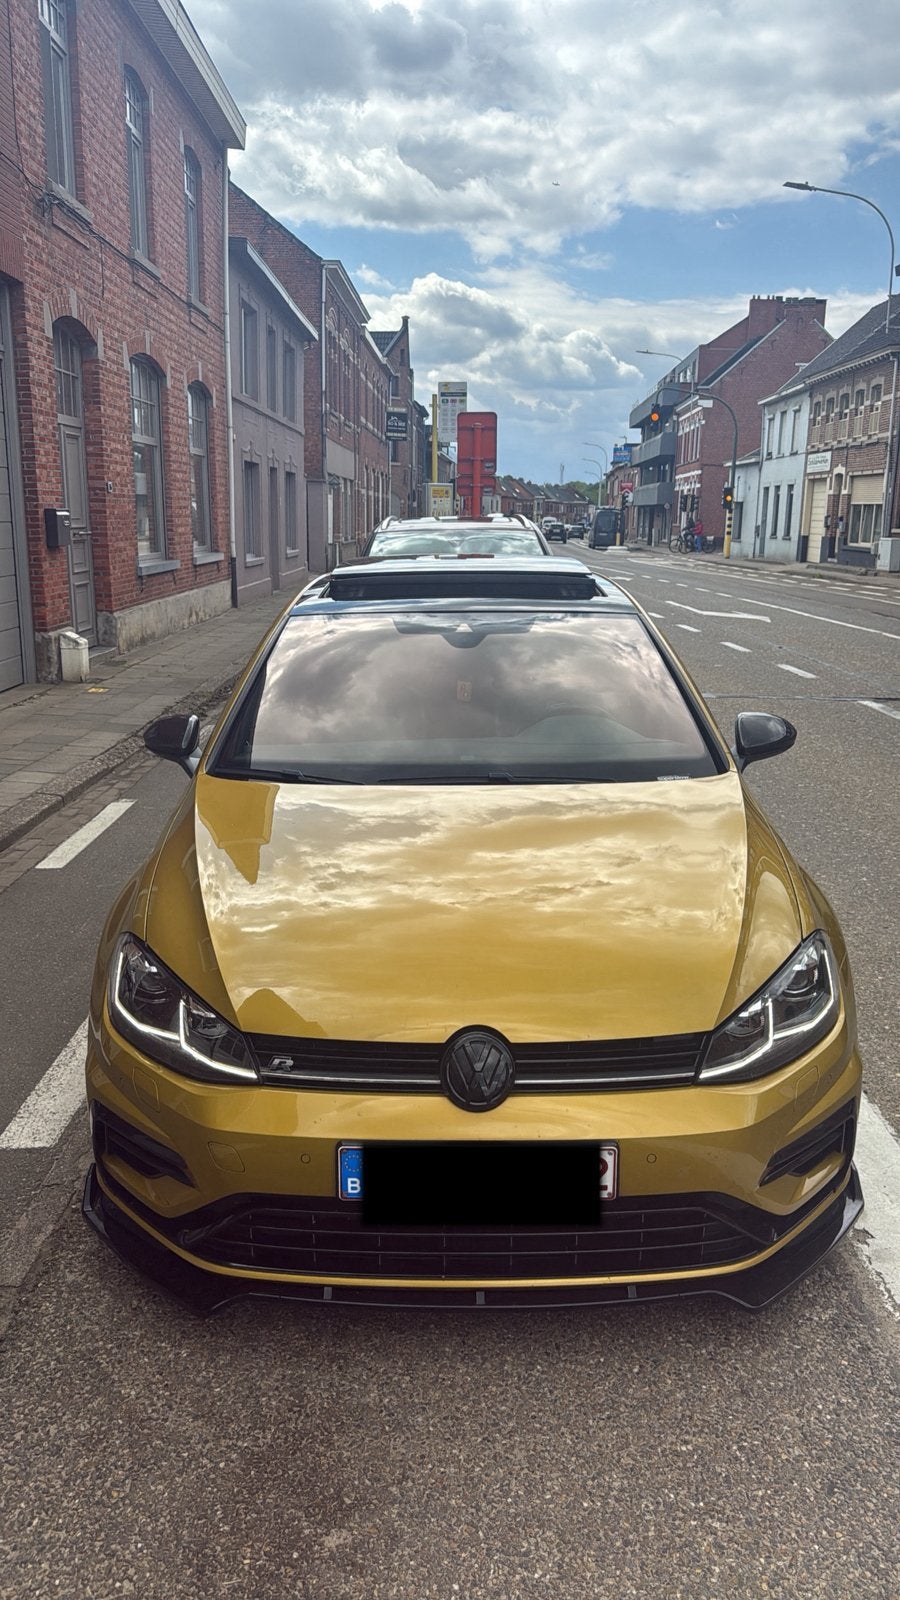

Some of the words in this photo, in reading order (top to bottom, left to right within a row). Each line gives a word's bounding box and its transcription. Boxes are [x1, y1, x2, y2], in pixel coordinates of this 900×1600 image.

[269, 1056, 294, 1072] R
[447, 1036, 511, 1102] VW
[347, 1177, 361, 1194] B
